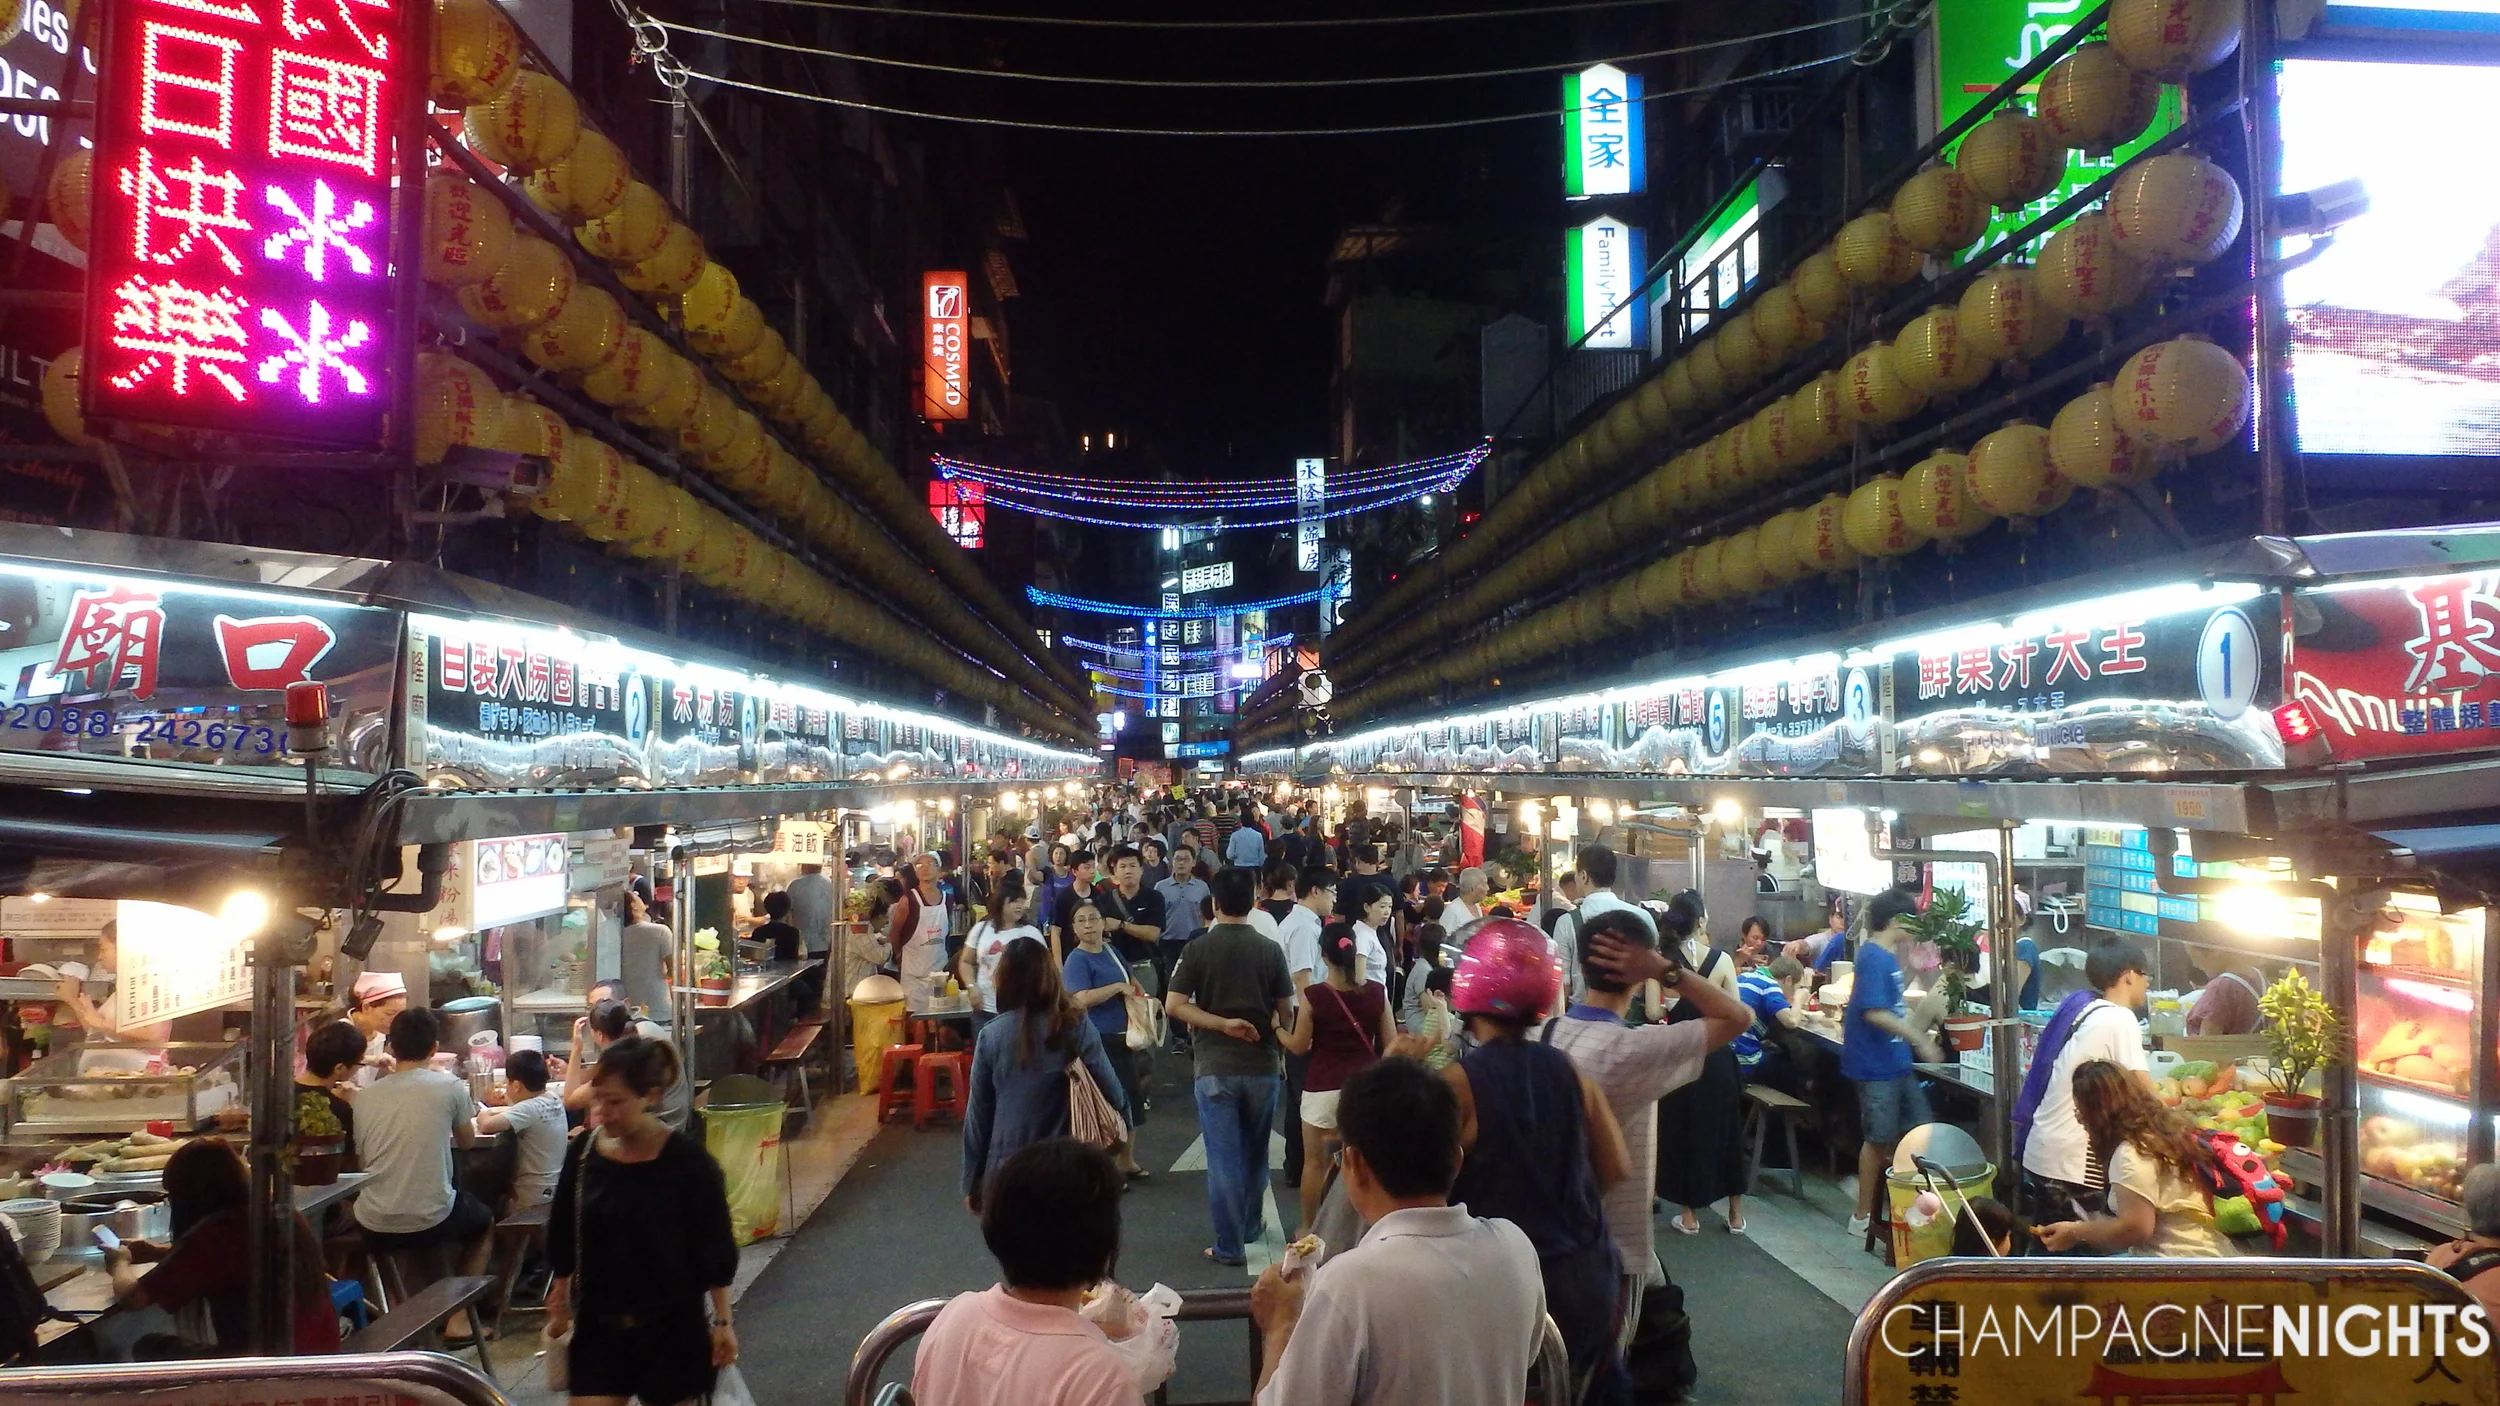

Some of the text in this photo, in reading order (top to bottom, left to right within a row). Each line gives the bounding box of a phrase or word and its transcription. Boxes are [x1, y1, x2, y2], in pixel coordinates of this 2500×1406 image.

[1586, 87, 1624, 168] 全家
[112, 0, 261, 402] 日快樂
[1596, 227, 1616, 338] FamilyMart
[932, 323, 945, 357] 康是美
[945, 323, 961, 406] COSMED
[47, 587, 337, 702] 廟口
[1917, 620, 2147, 700] 鮮果汁大王
[2218, 631, 2234, 700] 1
[631, 690, 643, 739] 2
[1713, 703, 1722, 742] 5
[1852, 683, 1865, 722] 3
[2030, 722, 2086, 754] Juice
[791, 831, 818, 854] 油飯
